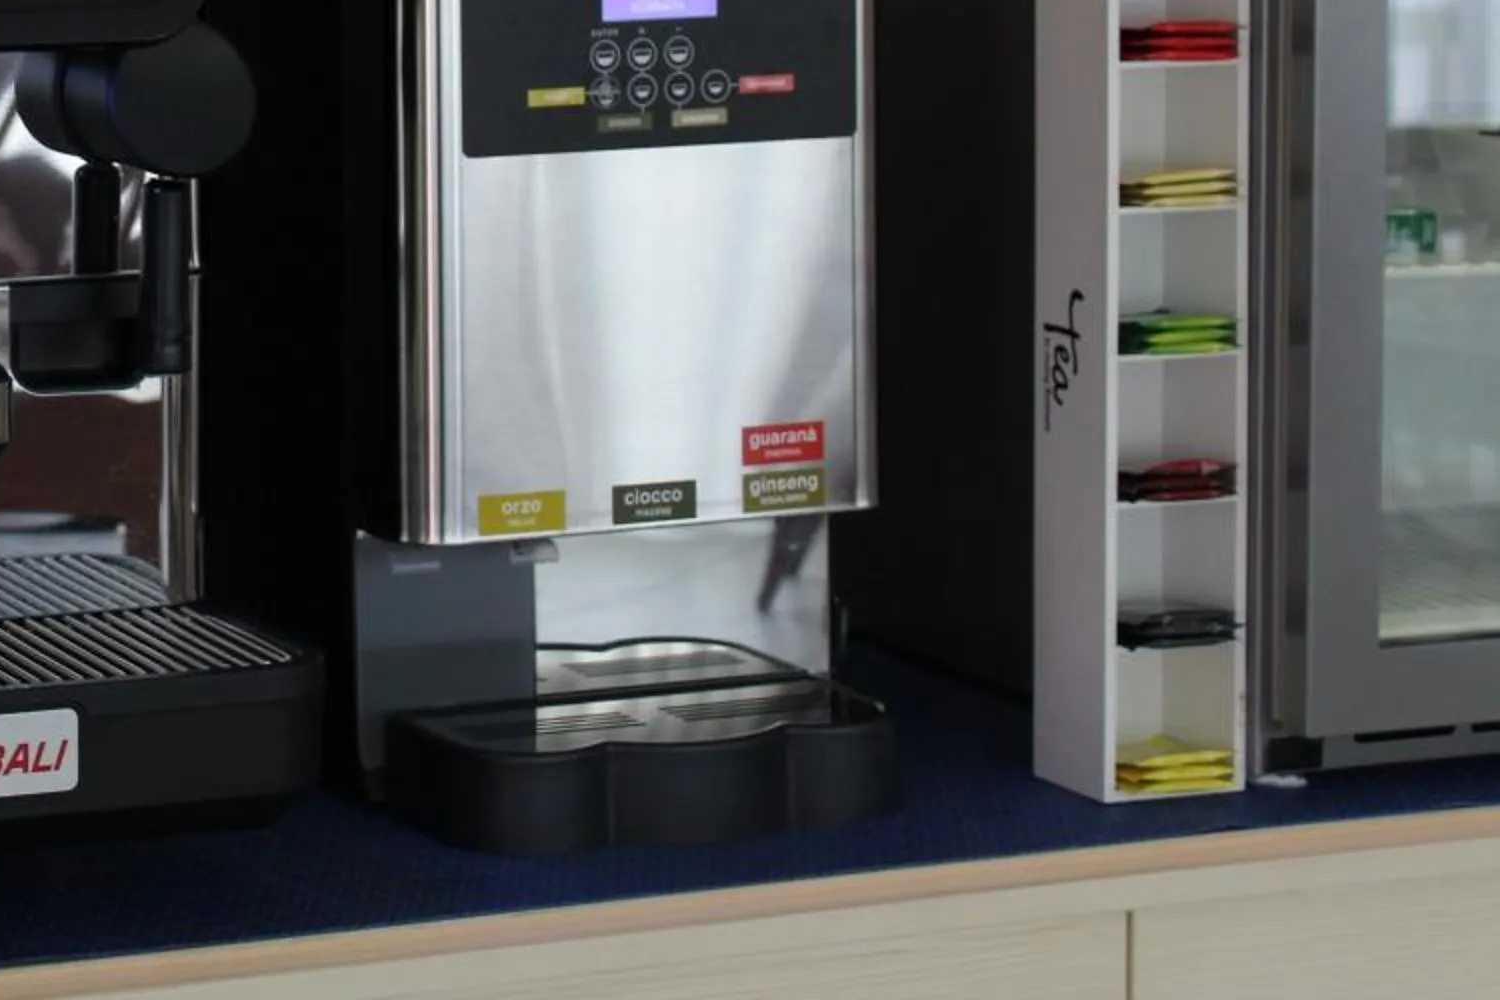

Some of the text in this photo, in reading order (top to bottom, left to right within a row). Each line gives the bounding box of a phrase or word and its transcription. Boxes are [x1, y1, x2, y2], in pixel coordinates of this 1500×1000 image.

[749, 475, 819, 499] ginseng
[624, 488, 684, 506] ciocco
[501, 499, 542, 516] orzo
